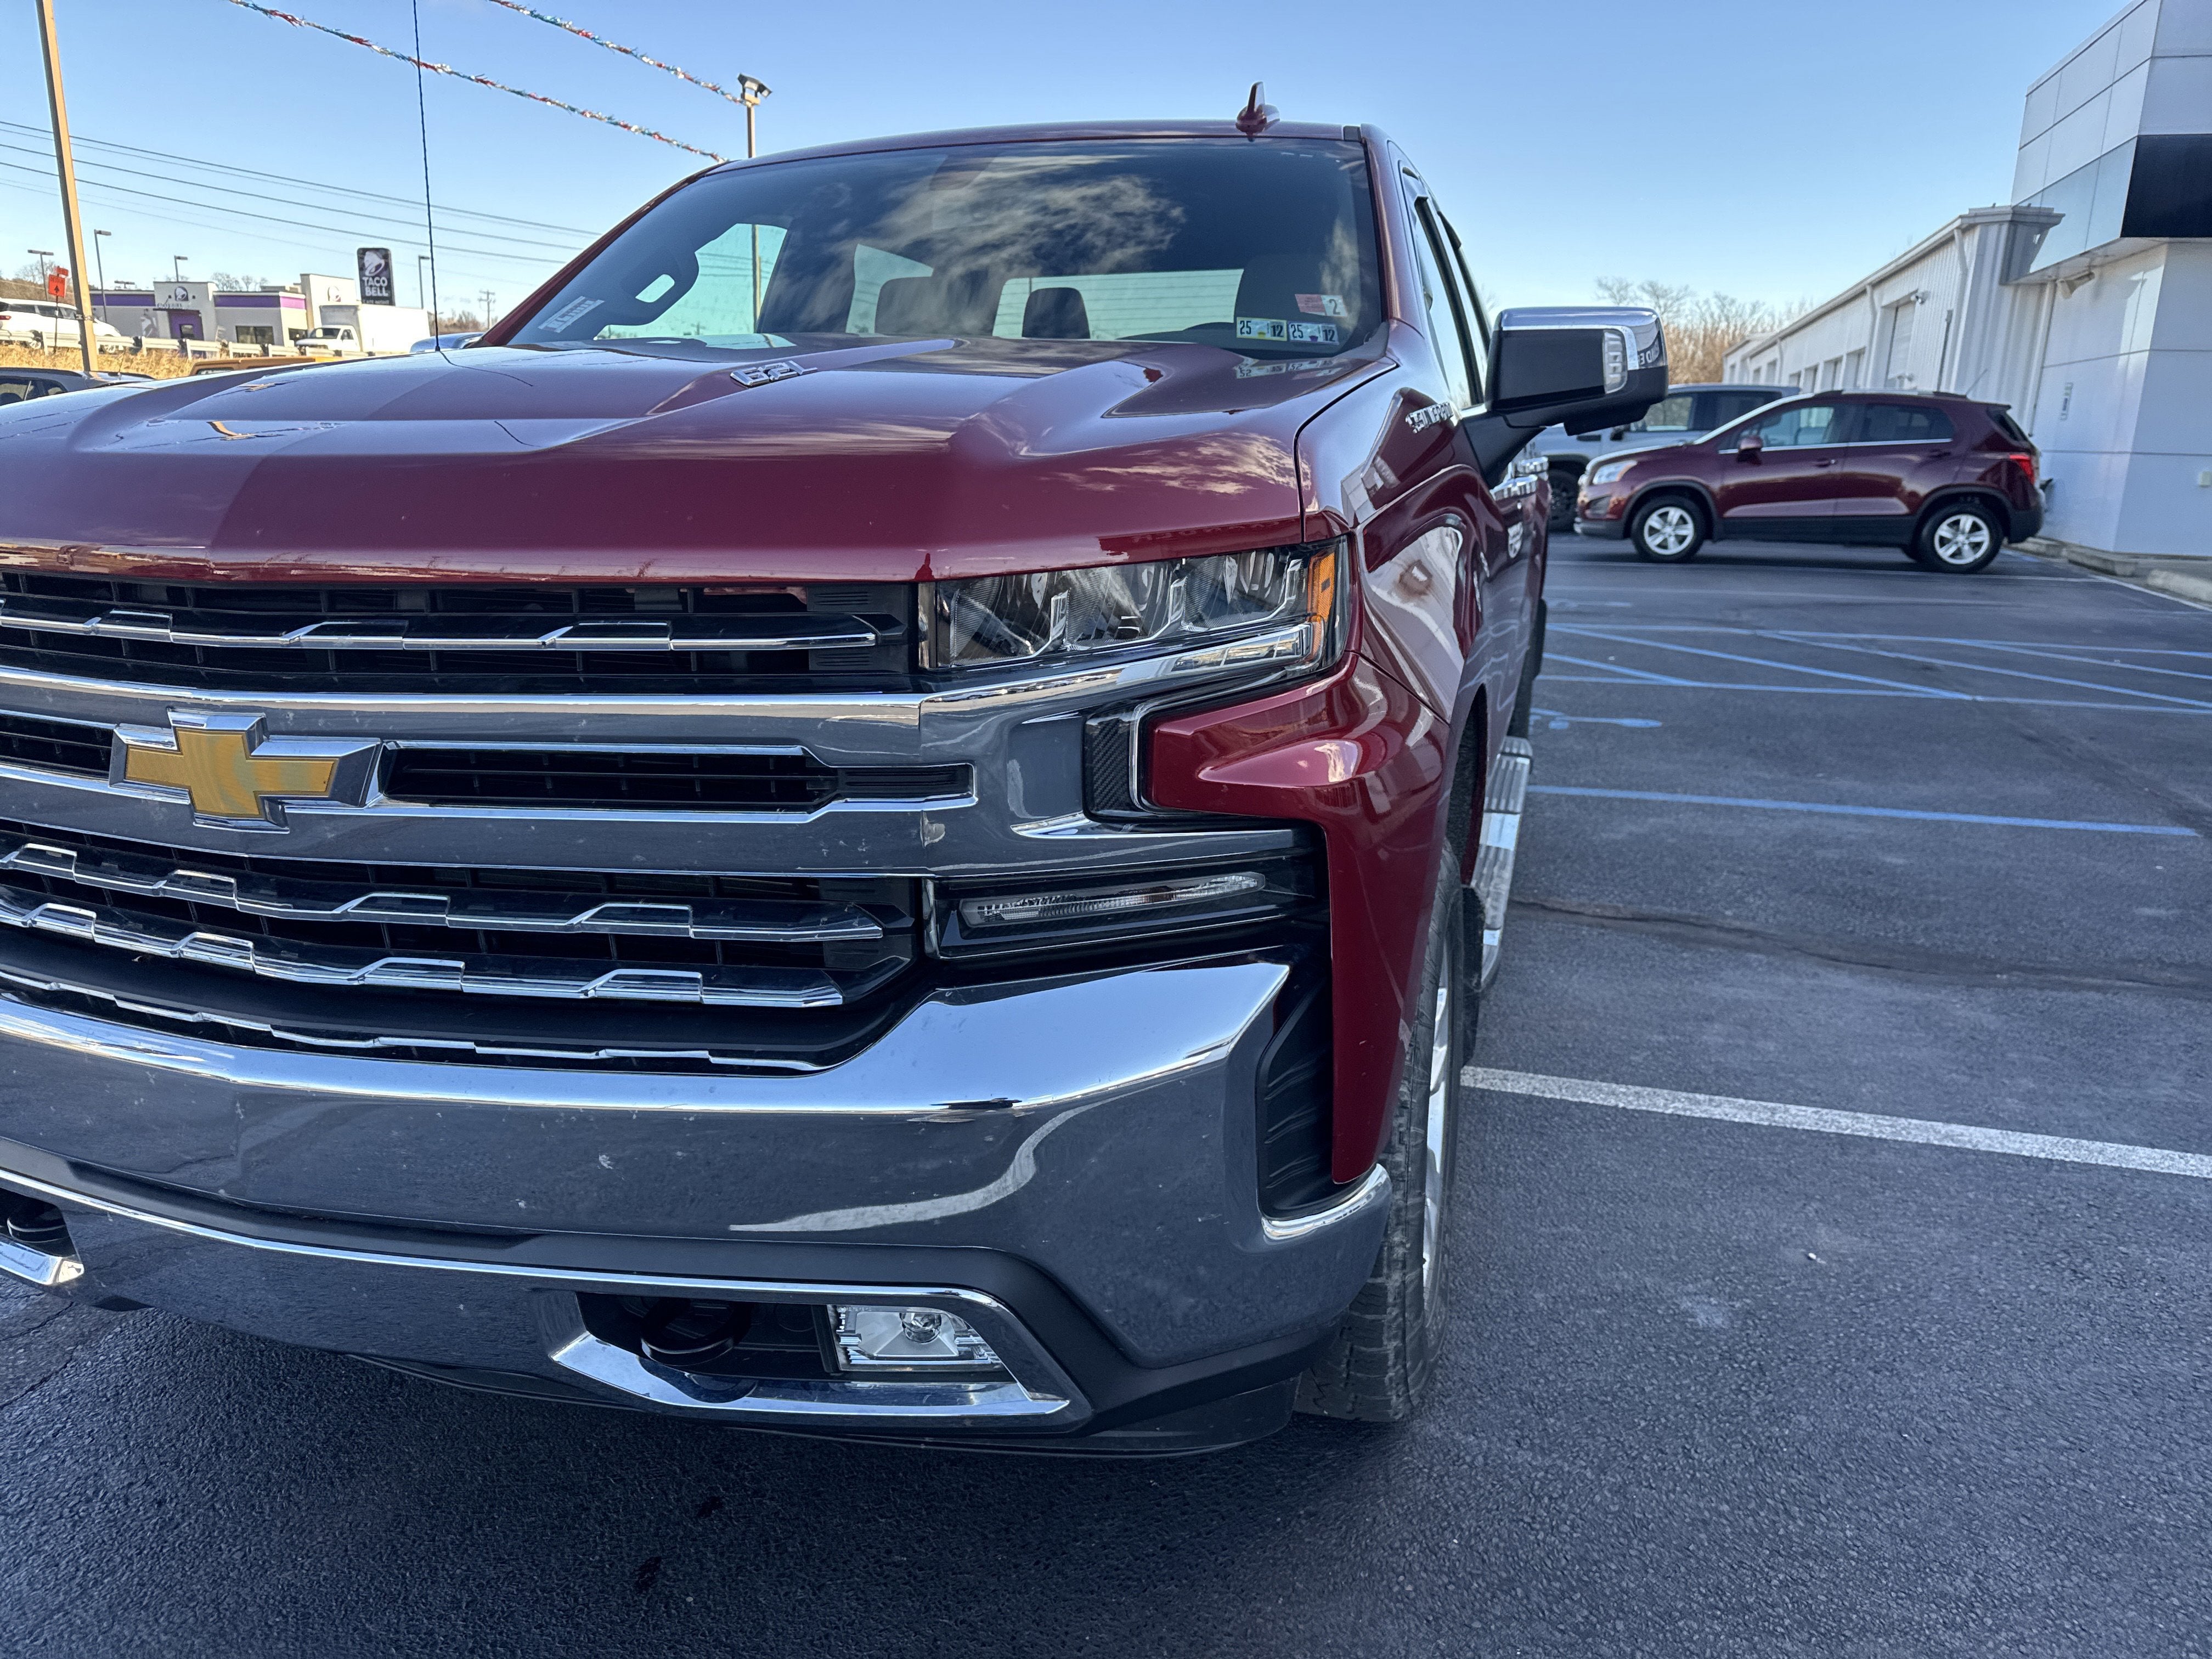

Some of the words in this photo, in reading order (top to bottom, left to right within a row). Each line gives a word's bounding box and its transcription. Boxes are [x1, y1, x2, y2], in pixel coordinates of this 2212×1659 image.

[362, 276, 388, 286] TACO
[365, 286, 388, 296] BELL
[1239, 320, 1252, 335] 25
[1271, 325, 1284, 337] 12
[1290, 324, 1304, 338] 25
[1323, 329, 1336, 342] 12
